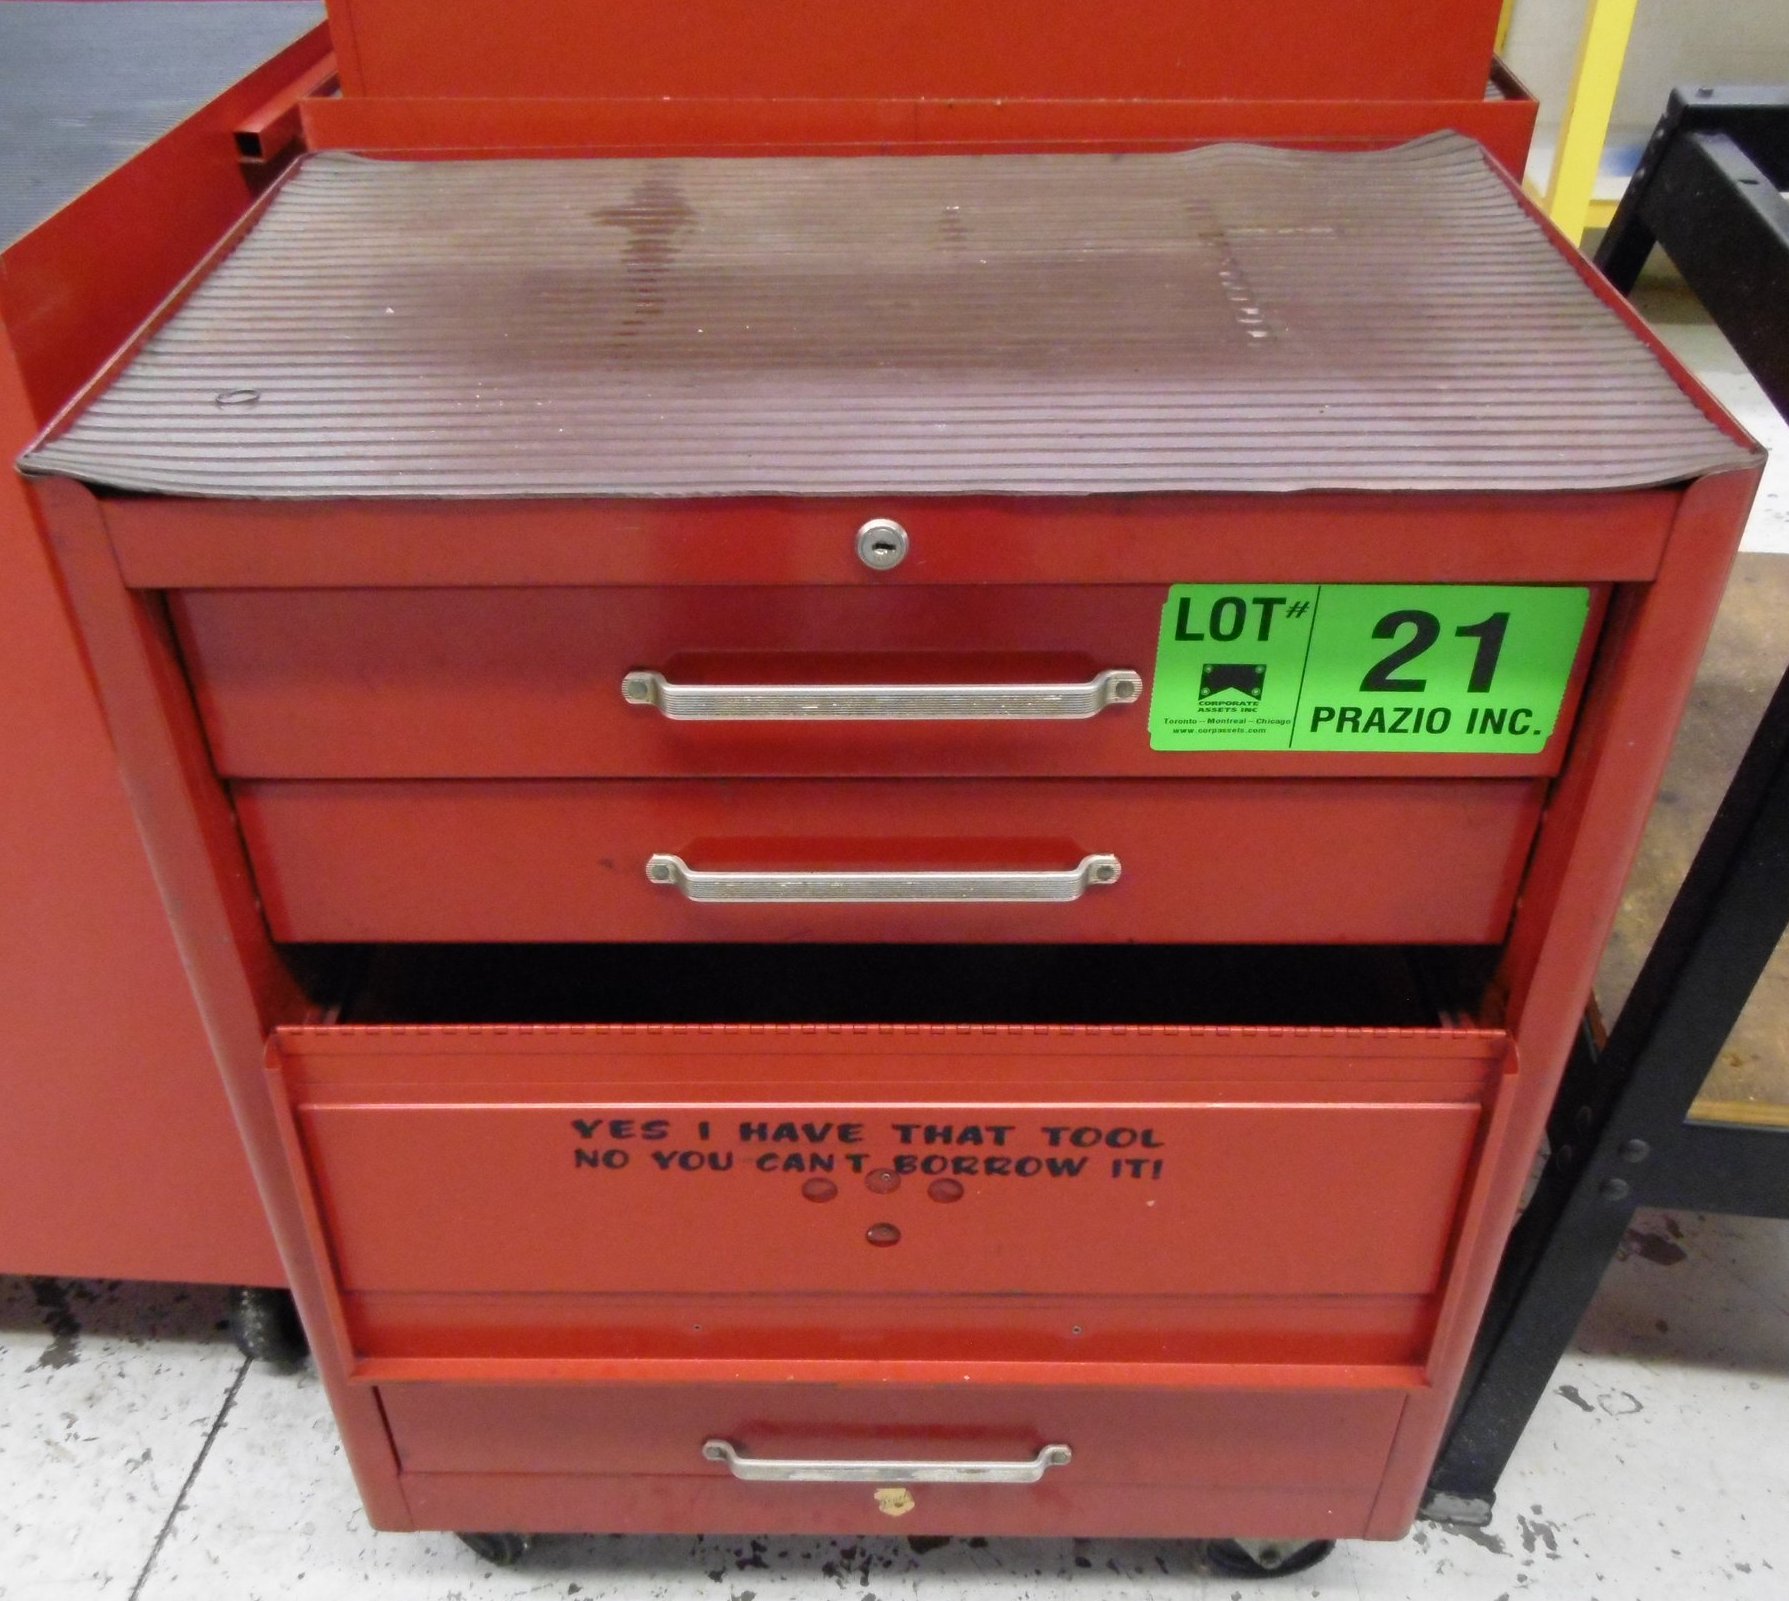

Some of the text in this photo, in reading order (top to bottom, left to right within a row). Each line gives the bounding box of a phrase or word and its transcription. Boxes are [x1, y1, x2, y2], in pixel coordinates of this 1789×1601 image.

[1358, 609, 1511, 694] 21
[1255, 718, 1292, 726] Chicago
[1310, 706, 1543, 736] PRAZIO INC.
[571, 1119, 1165, 1148] YES I HAVE THAT TOOL
[574, 1148, 629, 1169] NO
[651, 1150, 734, 1171] YOU
[893, 1154, 1089, 1177] BORROW
[1111, 1157, 1164, 1180] IT!
